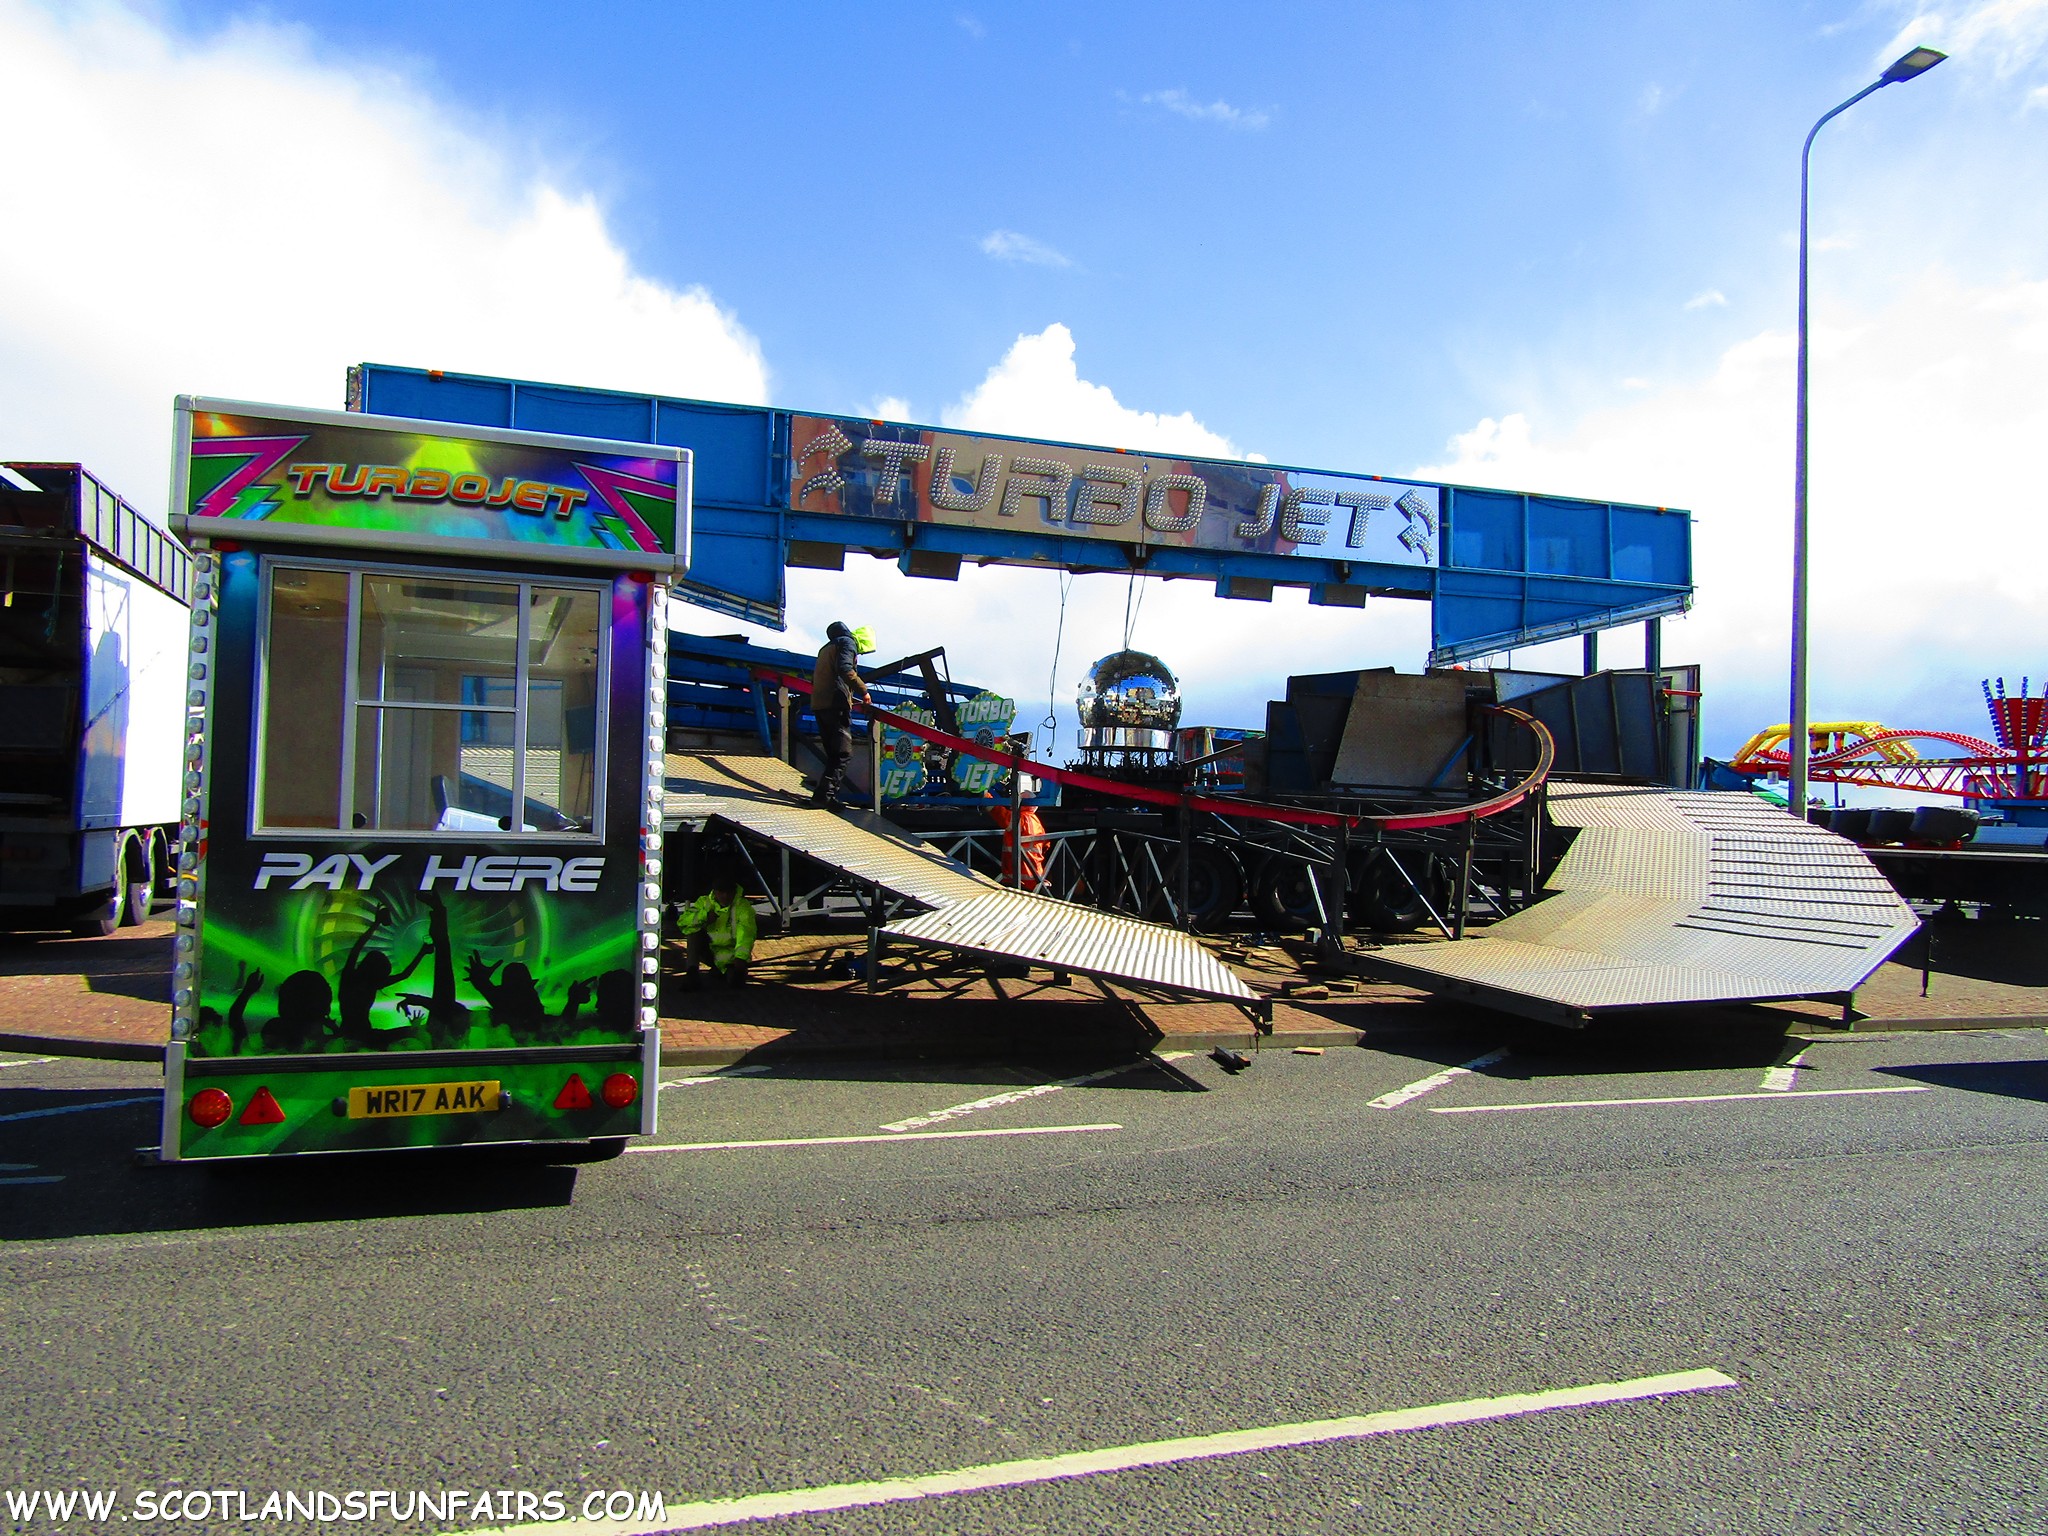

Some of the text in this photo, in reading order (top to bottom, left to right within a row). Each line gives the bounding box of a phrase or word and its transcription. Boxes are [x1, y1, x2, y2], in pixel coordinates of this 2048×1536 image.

[287, 462, 588, 517] TURBOJET
[861, 439, 1392, 549] TURBO JET
[959, 699, 1013, 722] TURBO
[881, 770, 916, 795] JET
[960, 764, 998, 790] JET
[253, 853, 606, 893] PAY HERE
[366, 1086, 485, 1114] WR17 AAK
